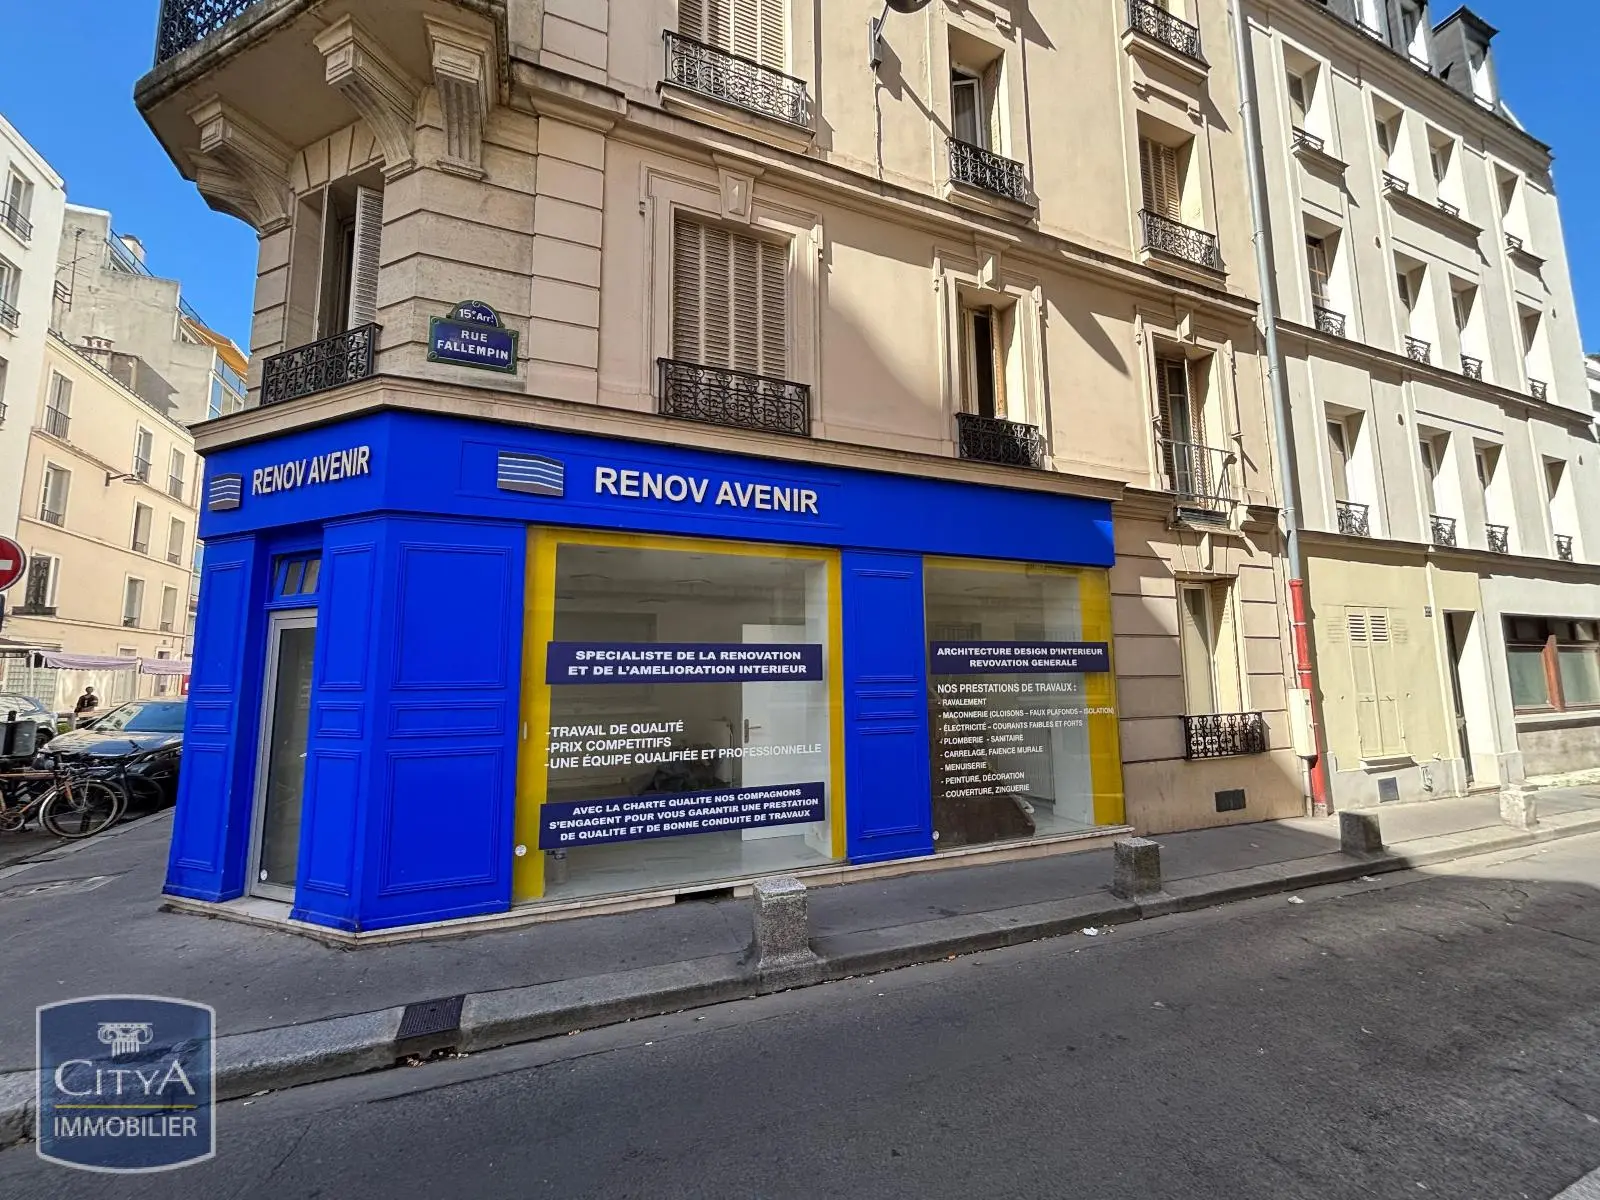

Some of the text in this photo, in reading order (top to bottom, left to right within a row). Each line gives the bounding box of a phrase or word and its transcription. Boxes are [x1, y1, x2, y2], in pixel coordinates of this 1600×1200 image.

[461, 329, 488, 343] RUE
[437, 339, 509, 360] FALLEMPIN
[252, 445, 369, 496] RENOV AVENIR
[595, 466, 818, 514] RENOV AVENIR
[575, 650, 801, 661] SPECIALISTE DE LA RENOVATION
[936, 647, 1103, 656] ARCHITECTURE DESIGN D'INTERIEUR
[568, 664, 807, 676] ET DE L'AMELIORATION INTERIEUR
[969, 659, 1078, 668] REVOVATION GENERALE
[937, 683, 958, 694] NOS
[960, 683, 1020, 693] PRESTATIONS
[1021, 683, 1033, 693] DE
[942, 698, 987, 706] RAVALEMENT
[1029, 708, 1046, 717] FAUX
[609, 724, 628, 735] DE
[630, 720, 684, 734] QUALITÉ
[992, 721, 1028, 730] COURANTS
[1028, 720, 1054, 728] FAIBLES
[585, 737, 672, 751] COMPETITIFS
[943, 736, 984, 745] PLOMBERIE
[990, 734, 1024, 743] SANITAIRE
[582, 754, 632, 767] ÉQUIPE
[634, 748, 699, 764] QUALIFIÉE
[701, 749, 717, 760] ET
[718, 743, 822, 759] PROFESSIONNELLE
[944, 749, 988, 758] CARRELAGE,
[1016, 745, 1044, 754] MURALE
[944, 761, 987, 771] MENUISERIE
[945, 775, 982, 785] PEINTURE,
[982, 771, 1025, 782] DÉCORATION
[945, 787, 994, 798] COUVERTURE,
[995, 784, 1030, 794] ZINGUERIE
[572, 788, 801, 816] AVEC LA CHARTE QUALITE NOS COMPAGNONS
[549, 798, 819, 830] S'ENGAGENT POUR VOUS GARANTIR UNE PRESTATION
[560, 809, 811, 841] DE QUALITE ET DE BONNE CONDUITE DE TRAVAUX
